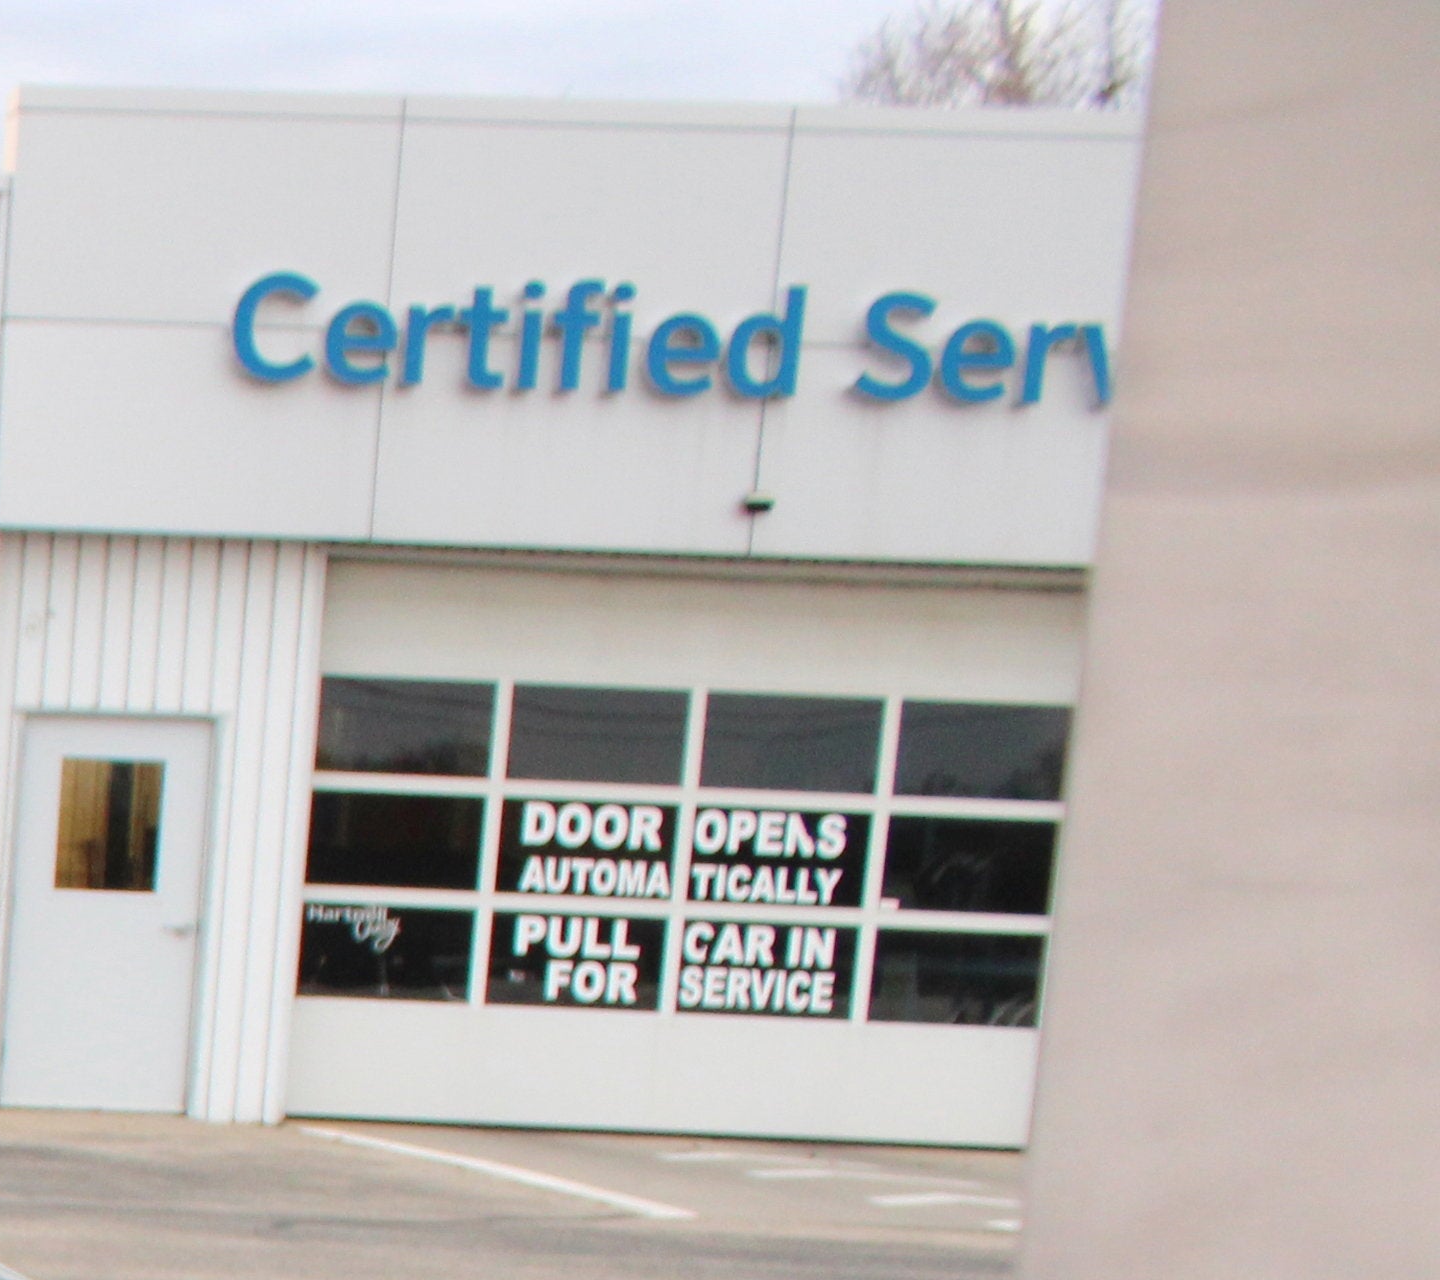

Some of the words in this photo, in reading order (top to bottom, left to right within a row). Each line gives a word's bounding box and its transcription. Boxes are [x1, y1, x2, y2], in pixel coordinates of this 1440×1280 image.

[232, 271, 808, 402] Certified
[521, 801, 664, 851] DOOR
[513, 914, 641, 961] PULL
[683, 921, 776, 968] CAR
[785, 925, 837, 970] IN
[544, 959, 639, 1005] FOR
[679, 965, 836, 1014] SERVICE
